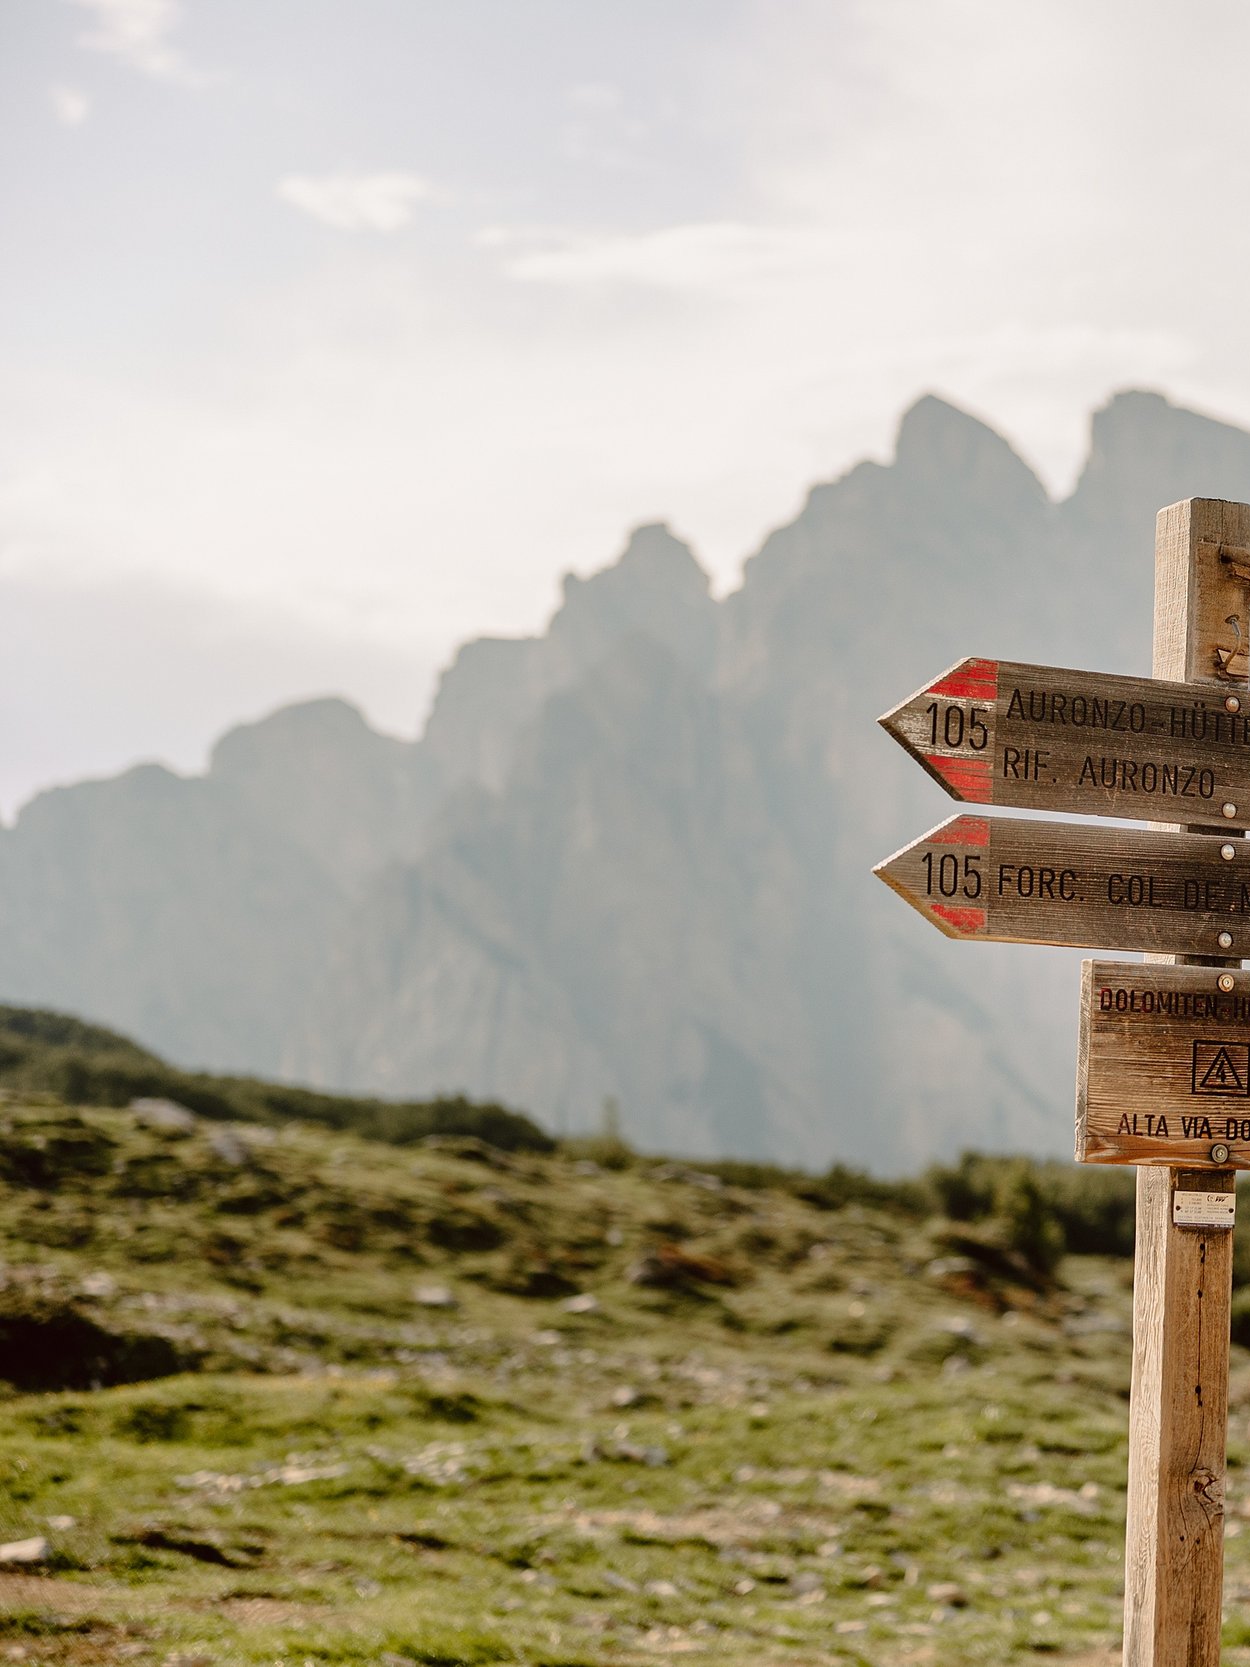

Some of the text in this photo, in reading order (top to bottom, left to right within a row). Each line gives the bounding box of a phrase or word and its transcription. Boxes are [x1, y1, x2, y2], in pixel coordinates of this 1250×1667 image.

[926, 702, 988, 750] 105
[1003, 747, 1215, 800] RIF. AURONZO
[921, 852, 982, 899] 105
[999, 864, 1085, 901] FORC.
[1107, 874, 1163, 908] COL
[1183, 879, 1220, 912] DE
[1216, 1060, 1227, 1083] 4
[1117, 1113, 1169, 1138] ALTA
[1181, 1116, 1213, 1139] VIA
